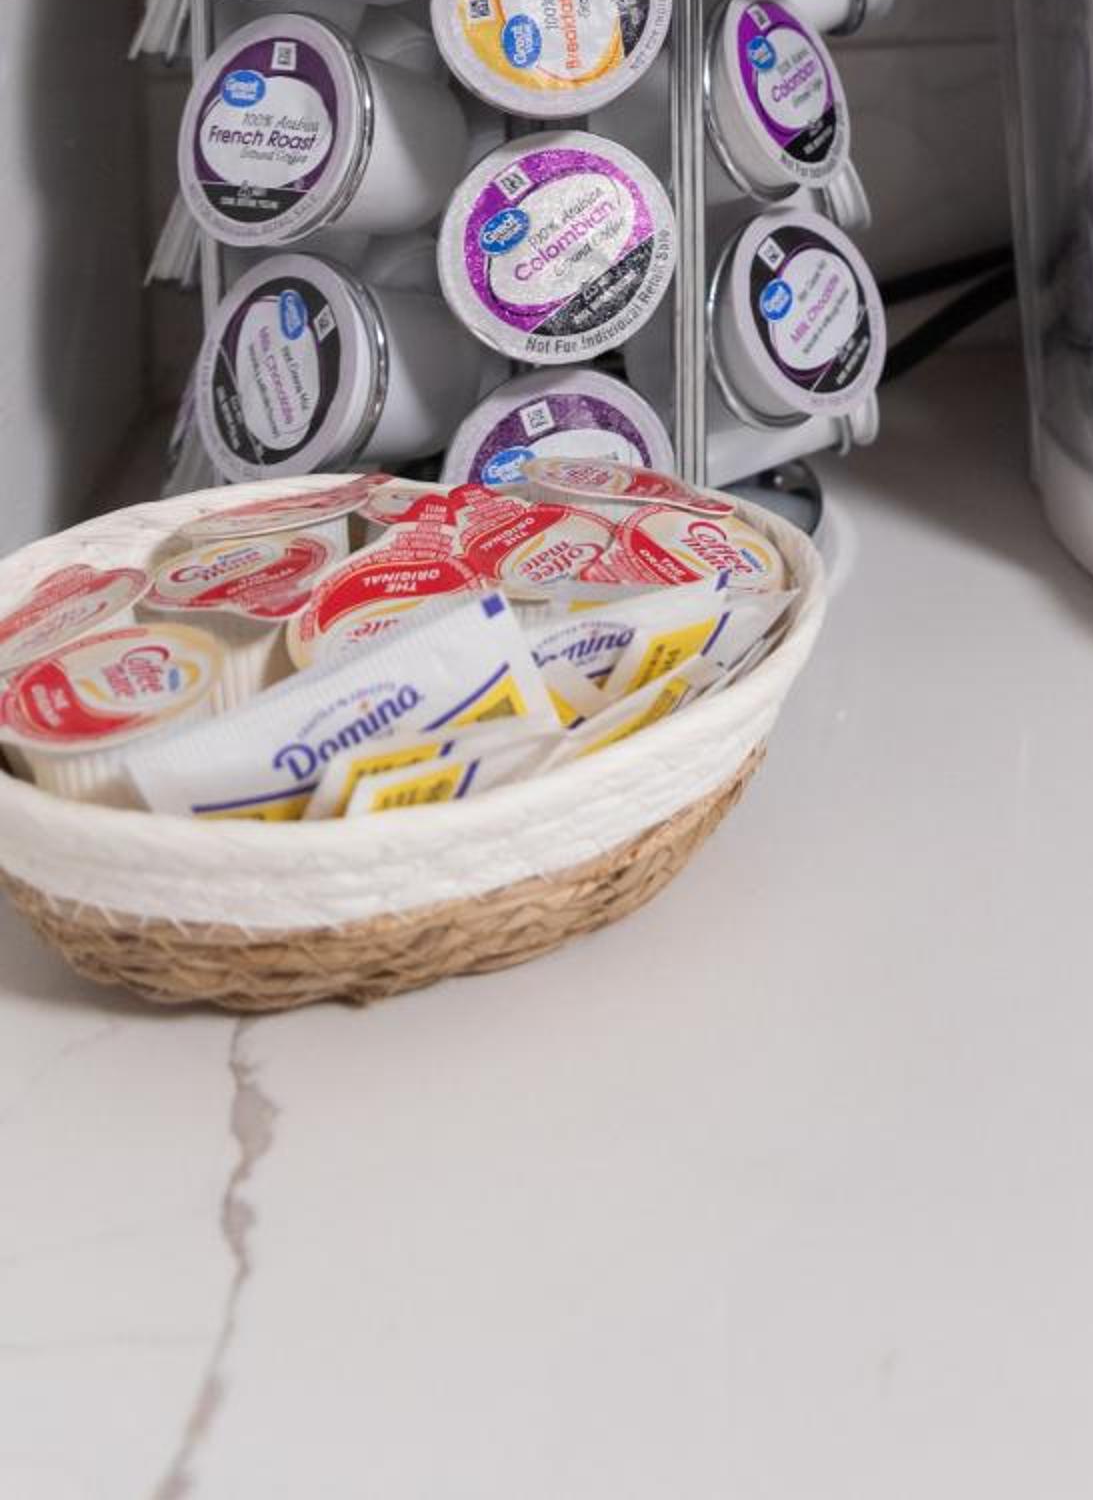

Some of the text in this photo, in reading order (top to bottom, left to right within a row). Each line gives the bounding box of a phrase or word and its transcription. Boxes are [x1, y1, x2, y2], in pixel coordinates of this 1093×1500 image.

[510, 24, 528, 64] Great
[771, 60, 819, 103] Colombian
[207, 125, 317, 151] French Roast
[241, 113, 274, 127] 100%
[513, 201, 616, 282] Colombian
[526, 336, 551, 355] Not
[554, 338, 578, 354] For
[581, 303, 643, 351] Individual
[638, 263, 665, 303] Retail
[790, 319, 811, 344] Milk
[806, 273, 841, 324] Chocolate
[479, 517, 536, 550] ORIGINAL
[504, 533, 529, 547] THE
[687, 521, 753, 574] Coffee
[519, 538, 571, 575] mate
[528, 543, 604, 582] Coffee
[362, 569, 441, 586] ORIGINAL
[385, 582, 418, 594] THE
[120, 645, 171, 694] Coffee
[272, 684, 424, 781] Domino
